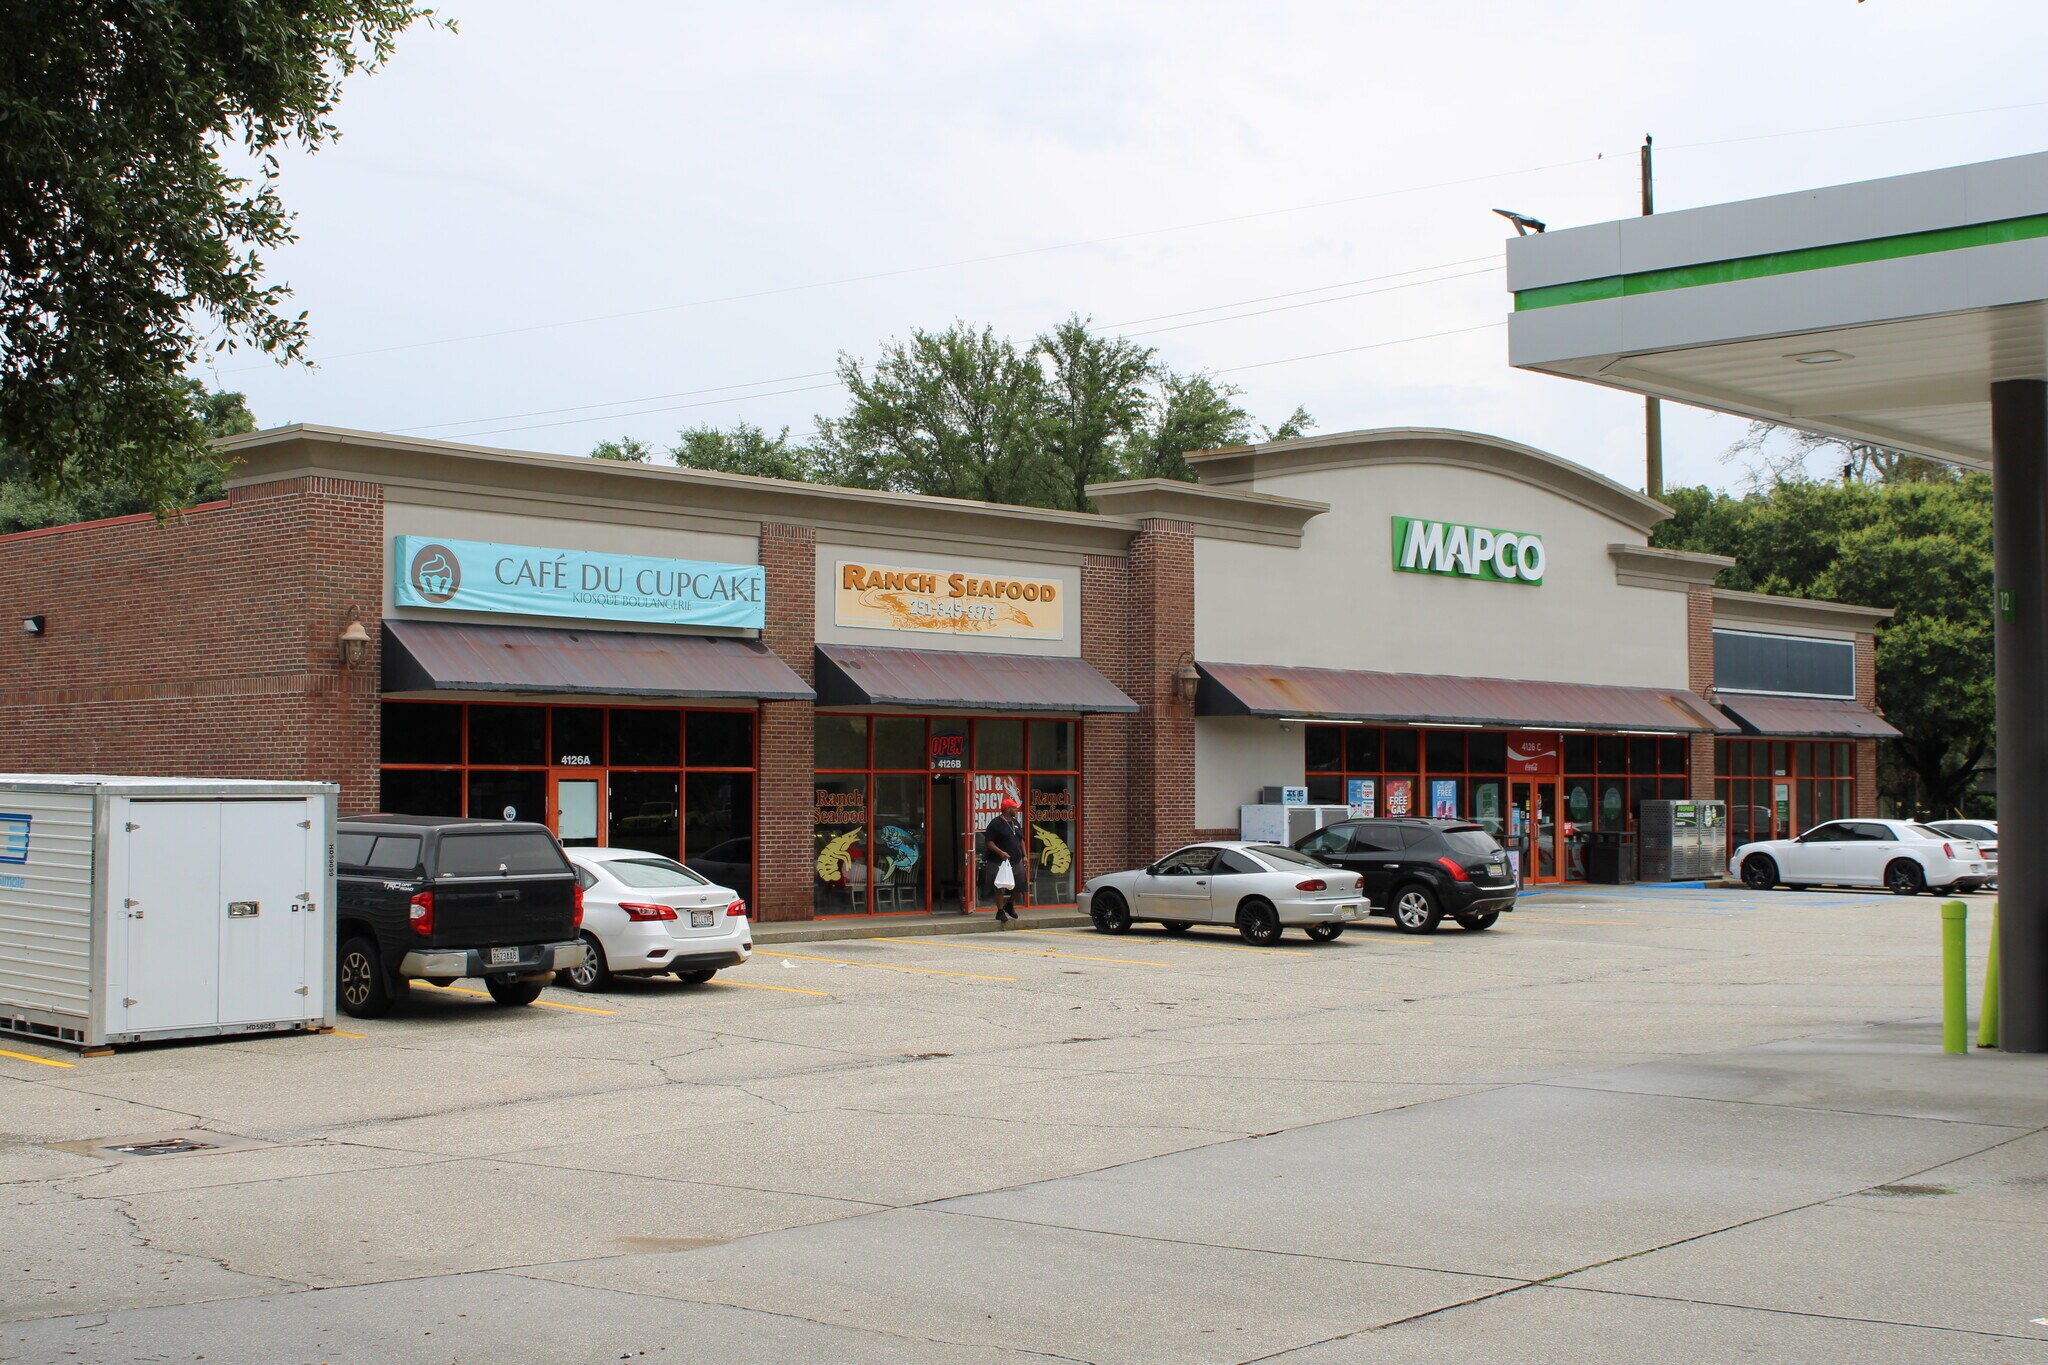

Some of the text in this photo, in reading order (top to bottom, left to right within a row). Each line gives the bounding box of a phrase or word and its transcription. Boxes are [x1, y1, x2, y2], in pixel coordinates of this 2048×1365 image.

[1401, 520, 1546, 581] MAPCO
[495, 553, 762, 603] CAFÉ DU CUPCAKE
[843, 564, 1056, 602] RANCH SEAFOOD
[573, 592, 692, 611] KIOSQUE BOULANGERIE
[2000, 592, 2010, 611] 12
[932, 736, 965, 756] OPEN
[1521, 743, 1535, 751] 4126
[561, 755, 591, 765] 4126A
[938, 760, 962, 768] 4126B
[995, 776, 1003, 791] &
[816, 788, 865, 806] Ranch
[975, 792, 1004, 810] SPICY
[1031, 788, 1072, 805] Ranch
[1389, 796, 1408, 805] FREE
[813, 806, 868, 825] Seafood
[1029, 805, 1076, 822] Seafood
[1391, 805, 1407, 815] GAS
[383, 881, 401, 890] TRD
[246, 1022, 276, 1031] HD59059
